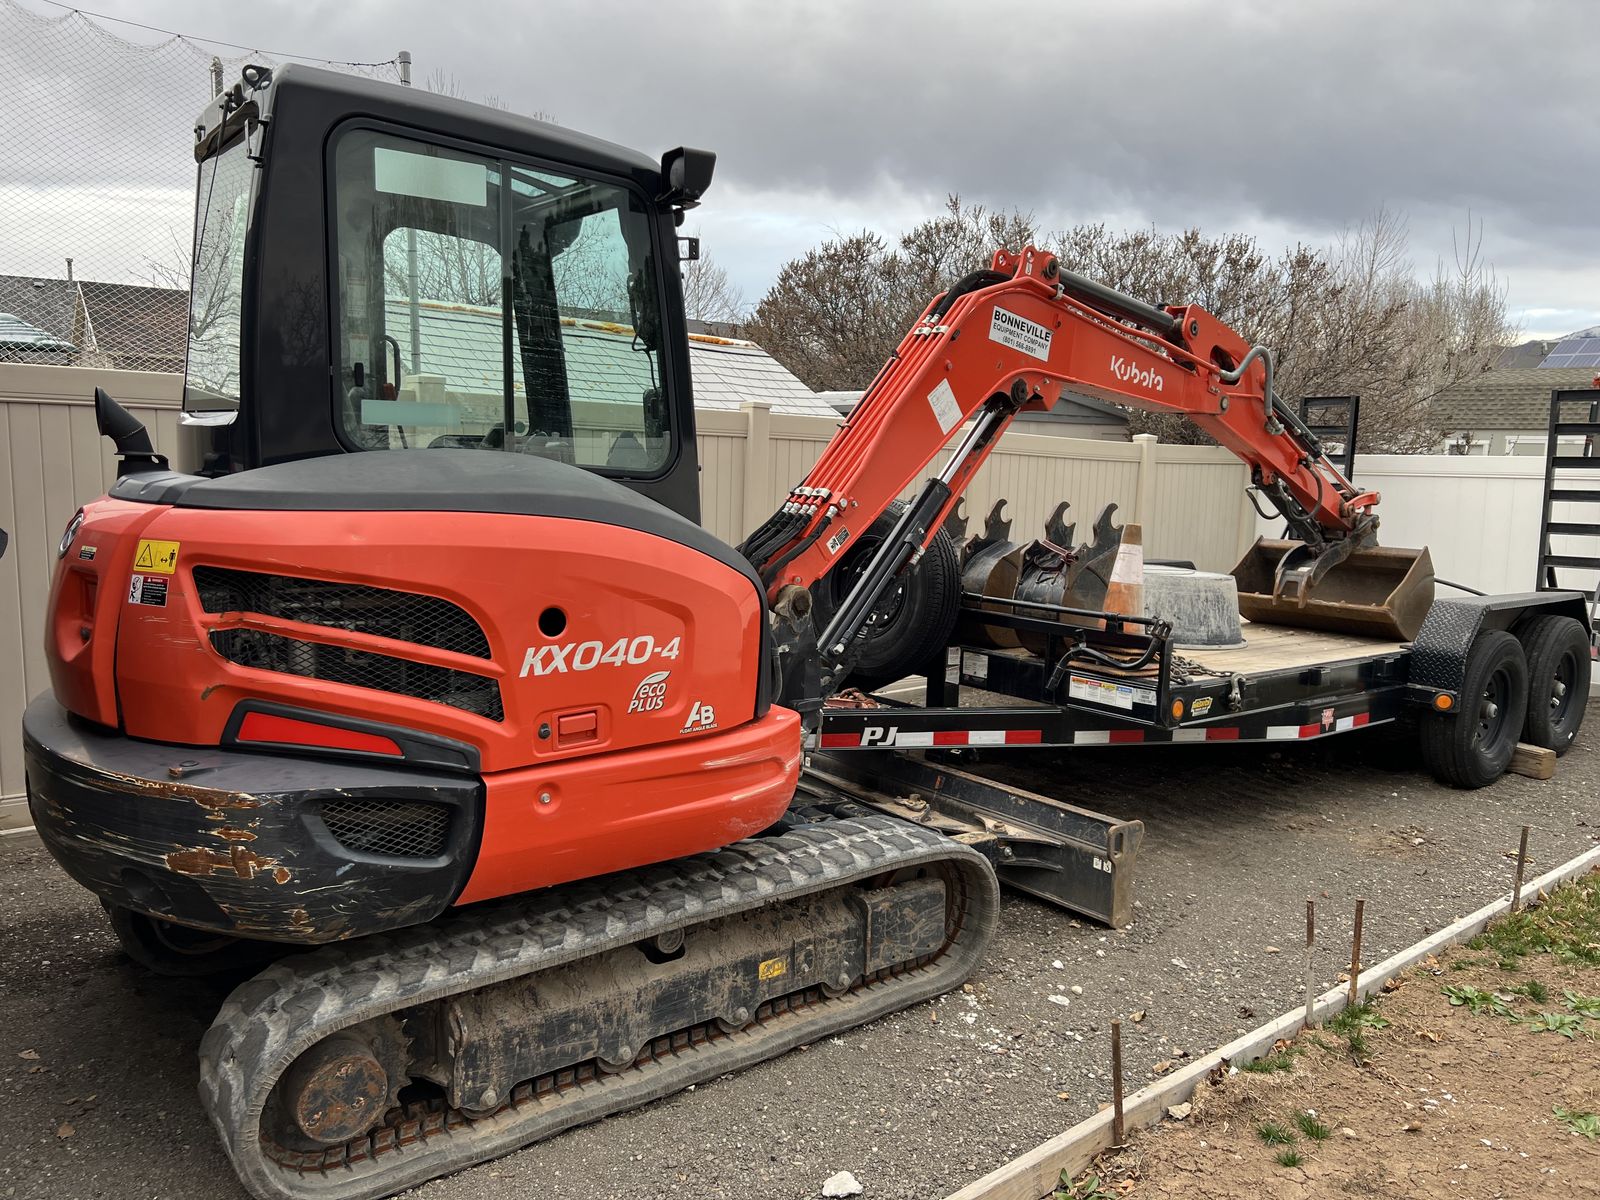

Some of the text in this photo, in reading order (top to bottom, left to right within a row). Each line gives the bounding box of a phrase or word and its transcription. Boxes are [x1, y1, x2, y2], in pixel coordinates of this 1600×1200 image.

[993, 323, 1049, 350] EQUIPMENT COMPANY
[994, 310, 1051, 342] BONNEVILLE
[1110, 355, 1164, 391] Kubota
[519, 635, 681, 678] KX040-4
[639, 682, 667, 698] eco
[627, 696, 665, 714] PLUS
[860, 726, 899, 746] PJ
